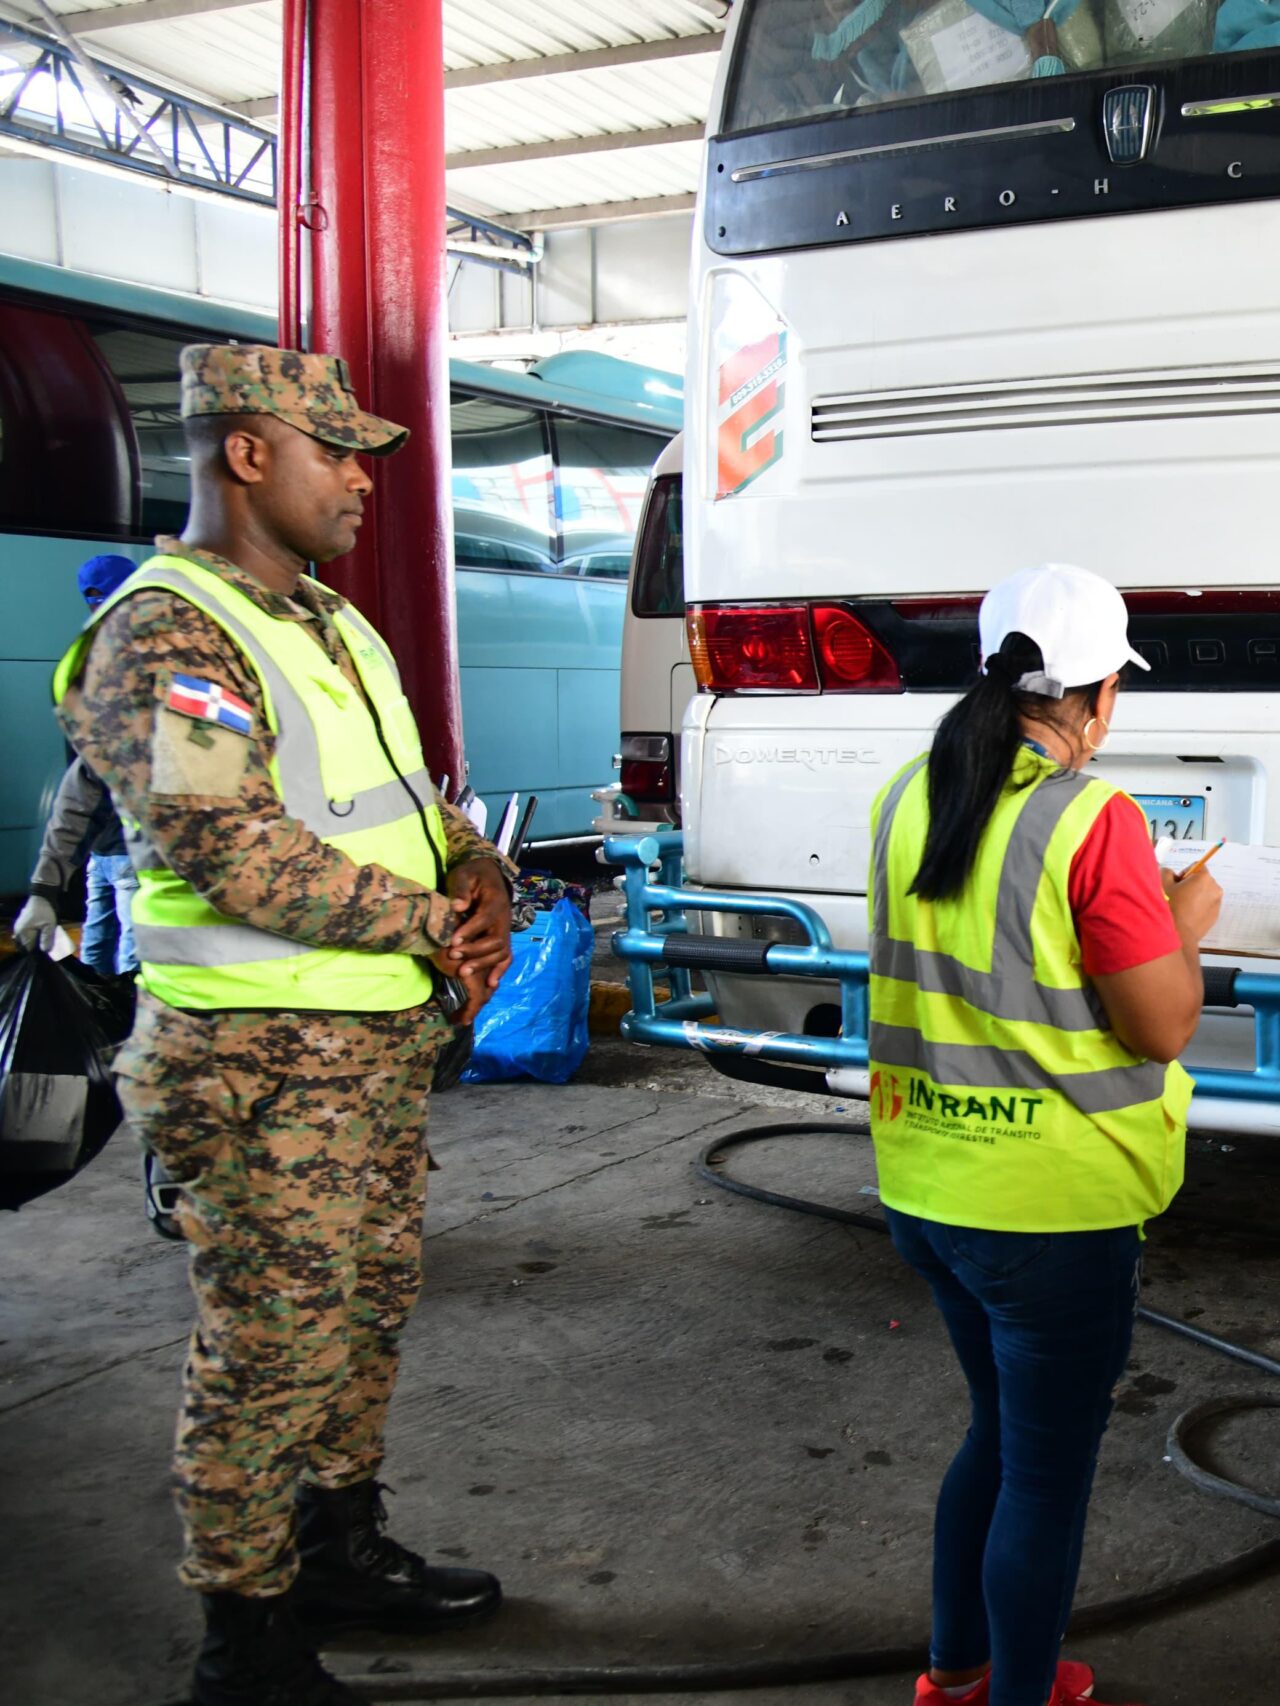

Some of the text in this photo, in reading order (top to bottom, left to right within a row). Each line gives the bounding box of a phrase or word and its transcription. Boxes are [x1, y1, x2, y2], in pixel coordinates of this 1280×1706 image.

[908, 1077, 1043, 1125] INRANT
[975, 1126, 987, 1134] DE
[990, 1125, 1041, 1140] TRÁNSITO
